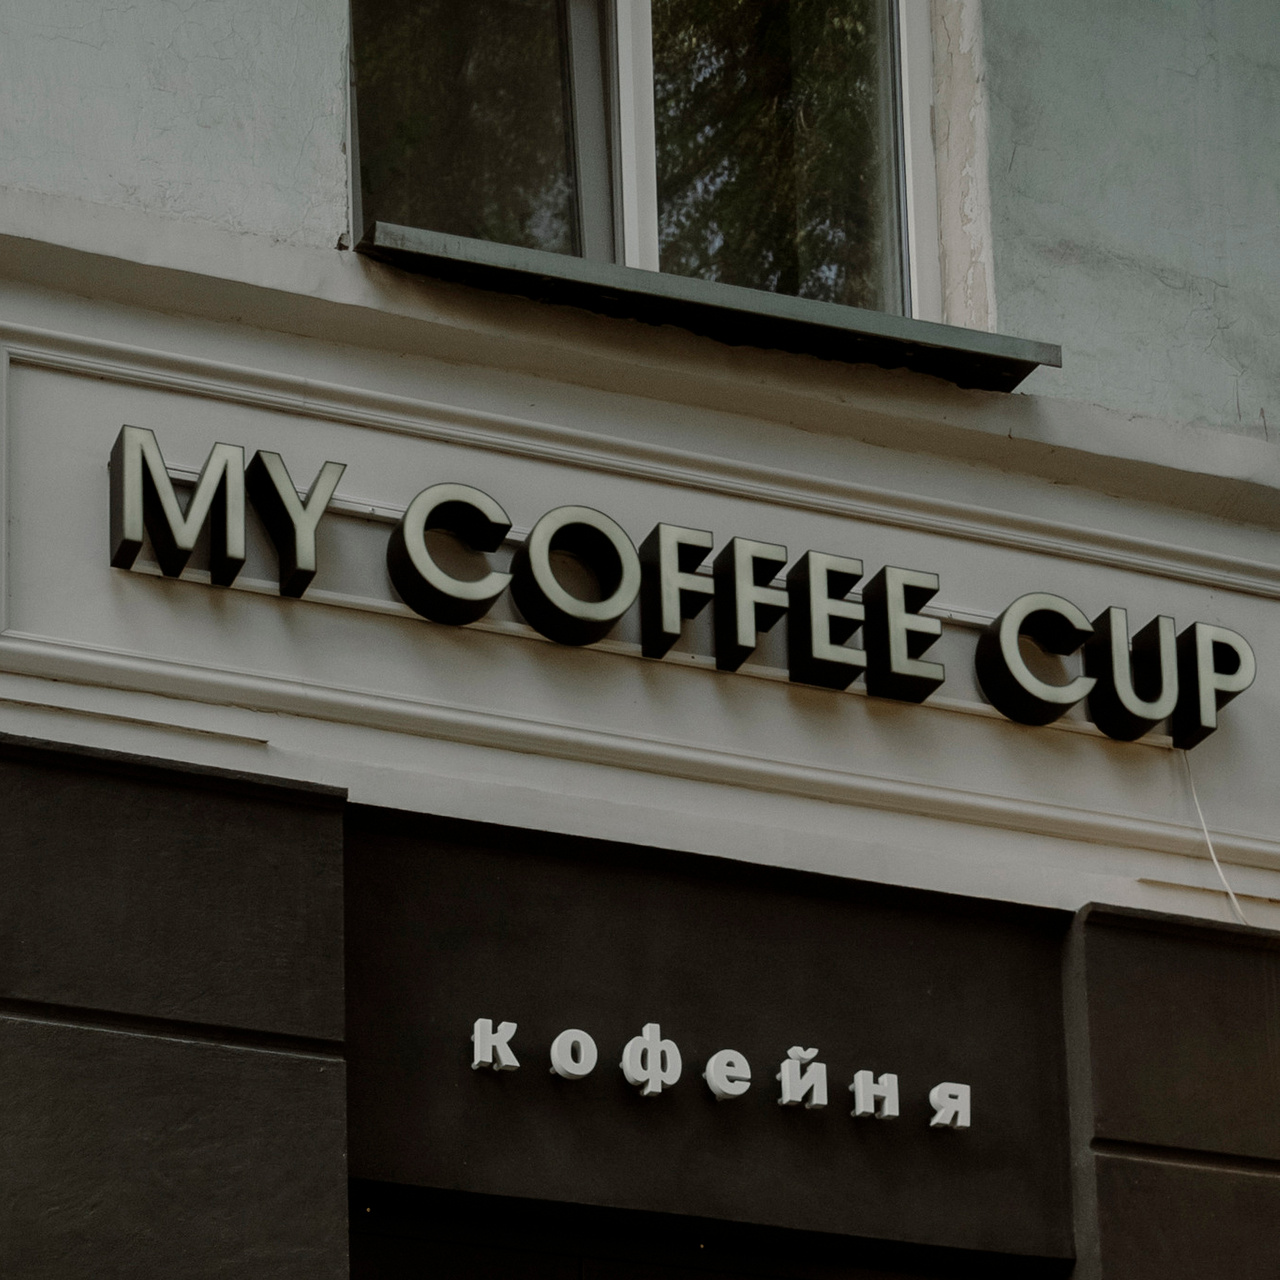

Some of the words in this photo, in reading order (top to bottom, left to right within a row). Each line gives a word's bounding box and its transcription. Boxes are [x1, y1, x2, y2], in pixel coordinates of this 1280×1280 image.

[110, 424, 348, 598] MY
[386, 482, 946, 703] COFFEE
[974, 592, 1257, 749] CUP
[470, 1017, 972, 1130] кофейня
